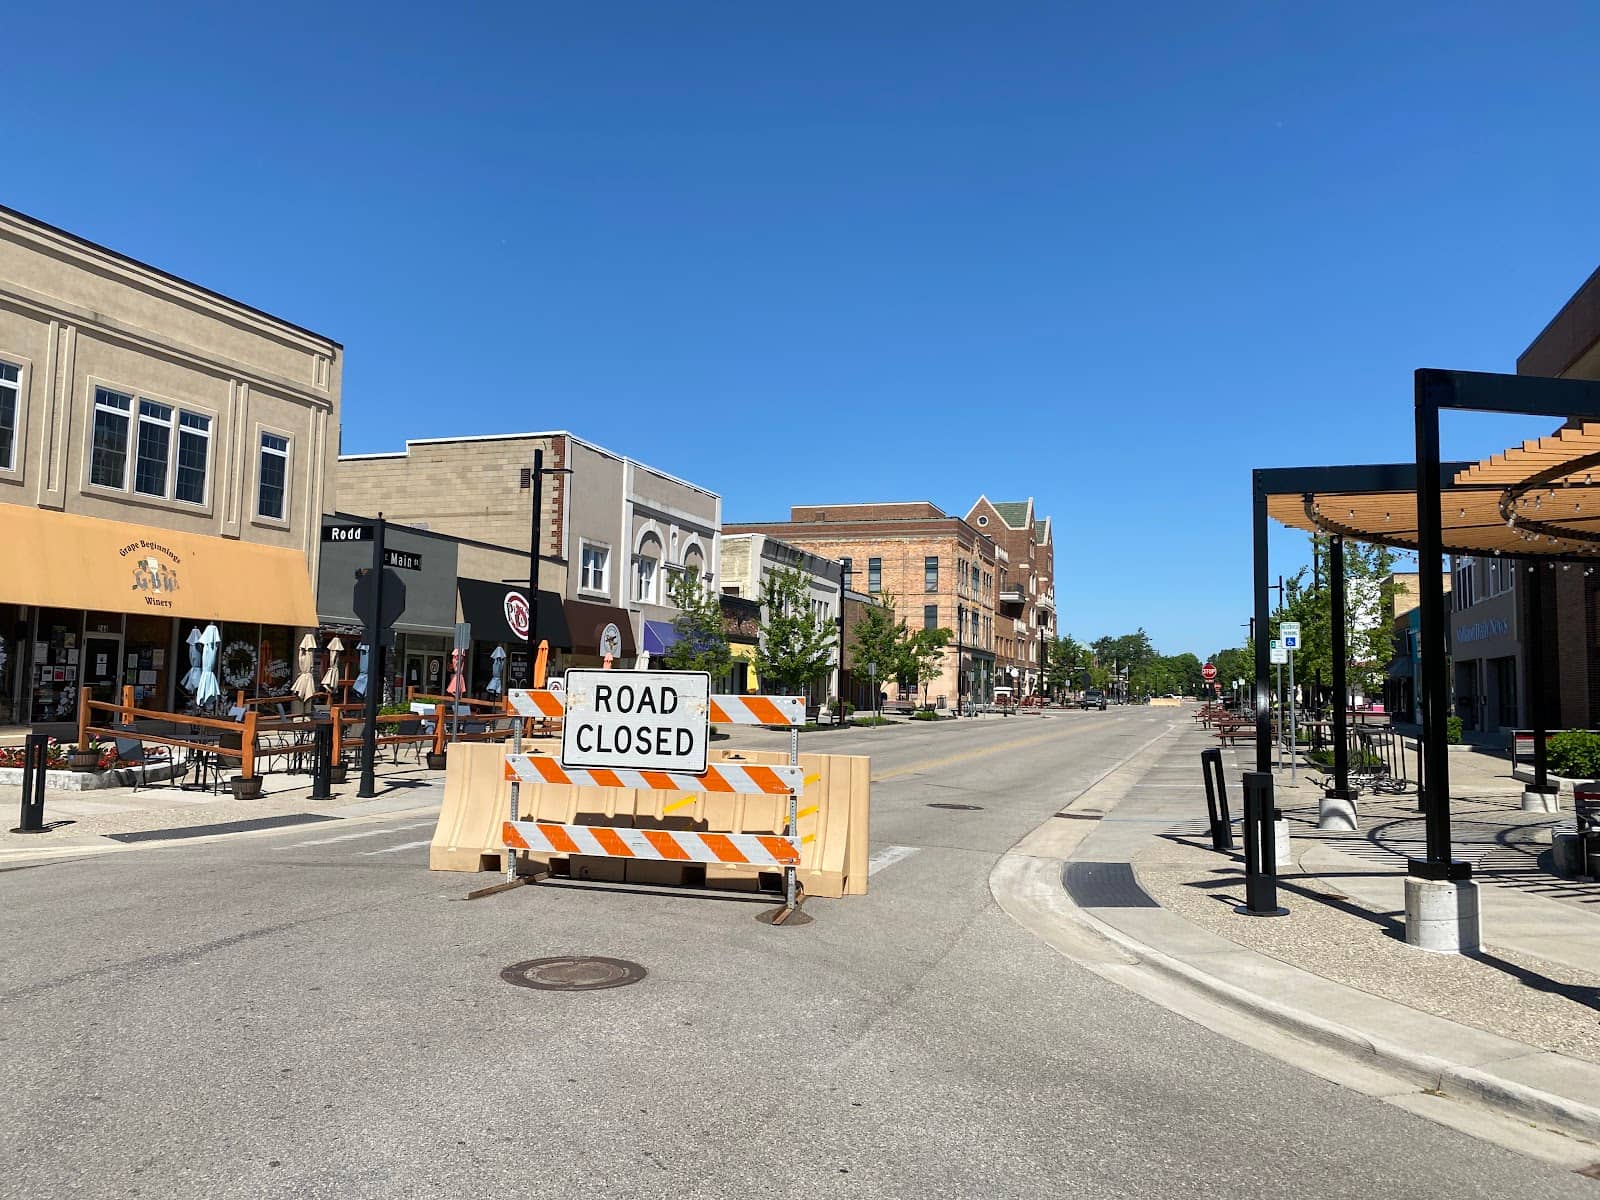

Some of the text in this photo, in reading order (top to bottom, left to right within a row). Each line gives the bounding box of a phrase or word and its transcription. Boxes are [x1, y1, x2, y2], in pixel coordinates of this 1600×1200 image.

[331, 527, 362, 540] Rodd
[119, 539, 181, 564] Grape Beginnings
[390, 552, 412, 568] Main
[144, 596, 173, 609] Winery
[594, 684, 678, 715] ROAD
[576, 723, 694, 756] CLOSED
